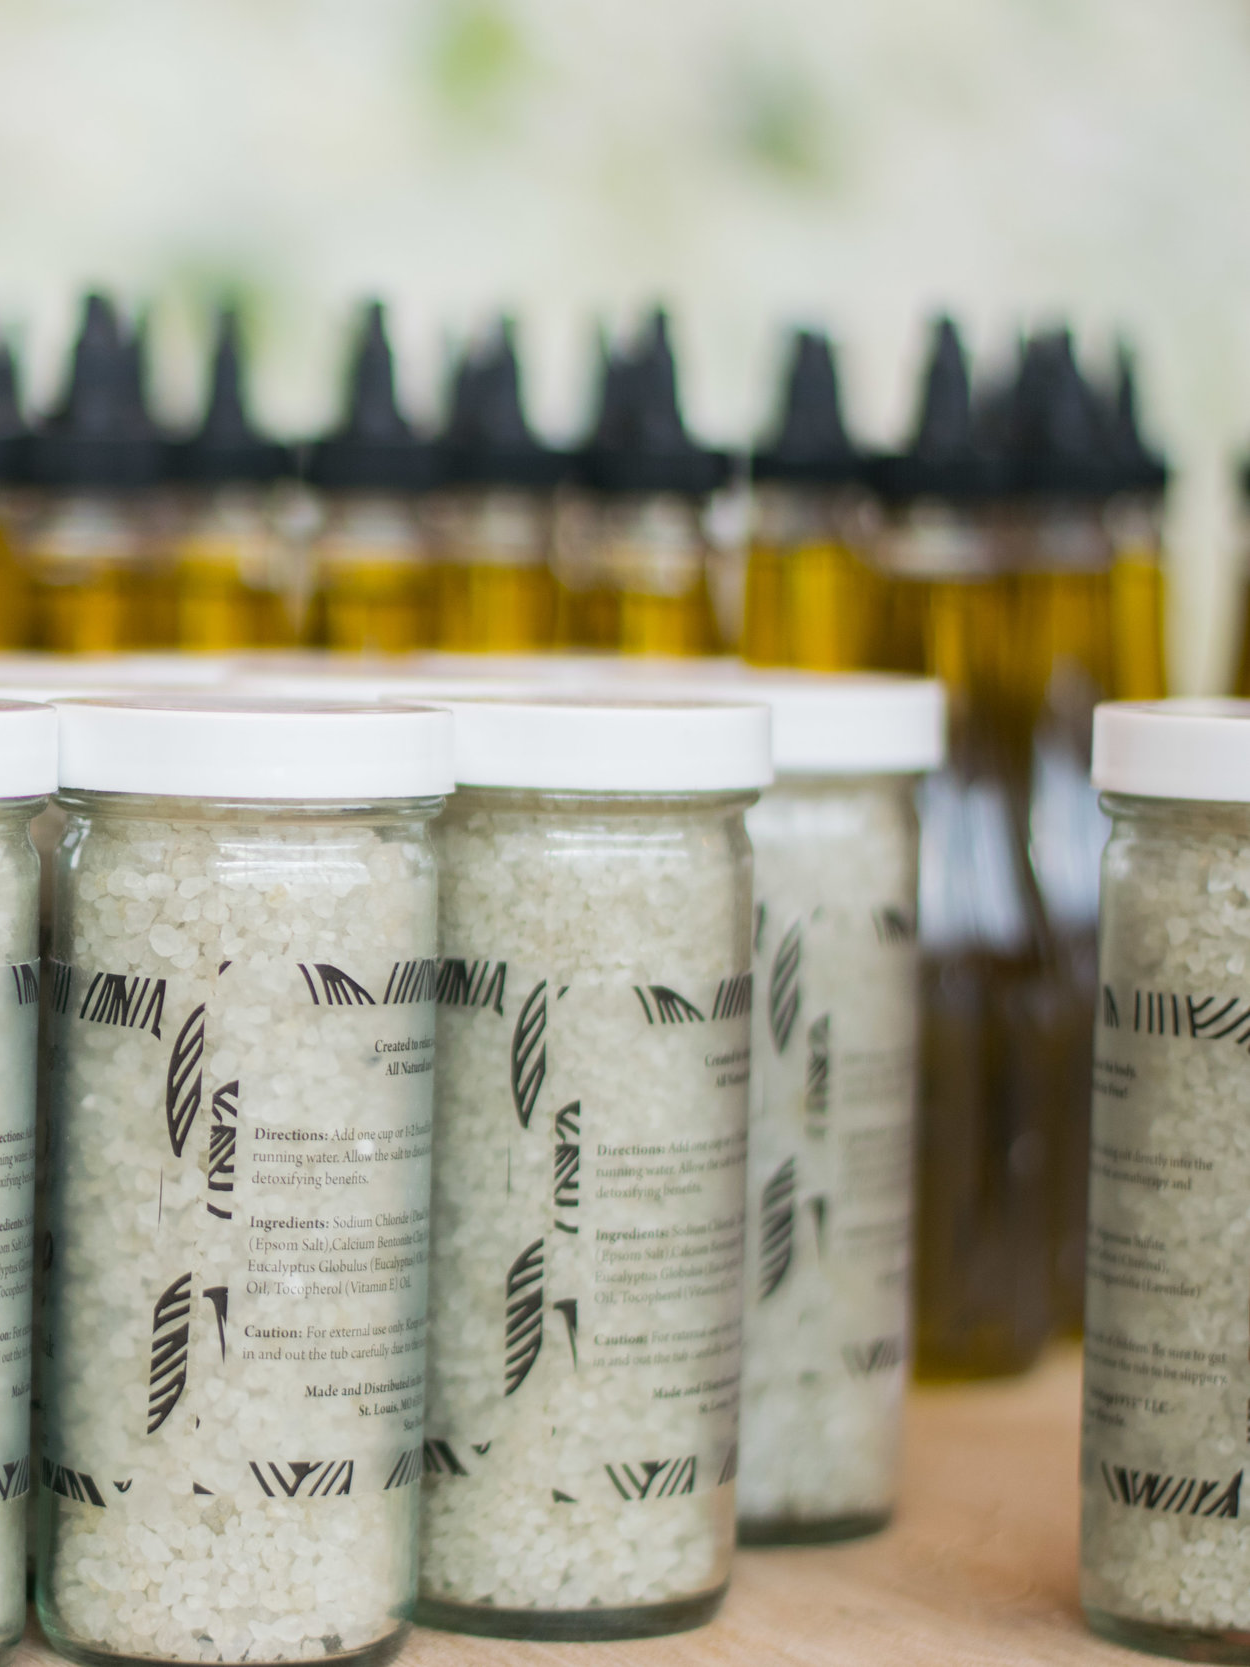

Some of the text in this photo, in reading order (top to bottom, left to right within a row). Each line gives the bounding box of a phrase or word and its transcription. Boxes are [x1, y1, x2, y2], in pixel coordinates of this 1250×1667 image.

[374, 1037, 410, 1053] Created
[385, 1061, 399, 1076] All
[254, 1127, 329, 1142] Directions:
[331, 1127, 355, 1141] Add
[357, 1130, 375, 1141] one
[377, 1129, 394, 1143] cup
[395, 1128, 404, 1138] or
[252, 1151, 303, 1167] running
[306, 1151, 340, 1163] water.
[341, 1149, 373, 1164] Allow
[374, 1148, 389, 1161] the
[390, 1146, 403, 1160] salt
[595, 1143, 666, 1157] Directions:
[251, 1170, 369, 1190] detoxifying benefits.
[595, 1166, 643, 1181] running
[595, 1185, 662, 1201] detoxifying
[249, 1215, 330, 1232] Ingredients:
[332, 1213, 373, 1229] Sodium
[375, 1210, 409, 1227] Chloride
[595, 1227, 669, 1245] Ingredients:
[248, 1237, 298, 1255] (Epsom
[247, 1259, 316, 1277] Eucalyptus
[318, 1258, 368, 1274] Globulus
[246, 1279, 270, 1297] Oil,
[273, 1280, 342, 1300] Tocopherol
[344, 1279, 387, 1298] (Vitamin
[389, 1277, 398, 1292] E)
[244, 1323, 302, 1339] Caution:
[306, 1325, 327, 1339] For
[329, 1323, 371, 1338] external
[372, 1325, 386, 1336] use
[241, 1349, 254, 1360] in
[258, 1347, 282, 1360] and
[284, 1348, 306, 1361] out
[308, 1347, 327, 1360] the
[330, 1346, 348, 1360] tub
[350, 1343, 389, 1360] carefully
[304, 1384, 338, 1399] Made
[341, 1382, 362, 1396] and
[364, 1376, 409, 1395] Distributed
[358, 1402, 372, 1417] St.
[373, 1401, 399, 1415] Louis,
